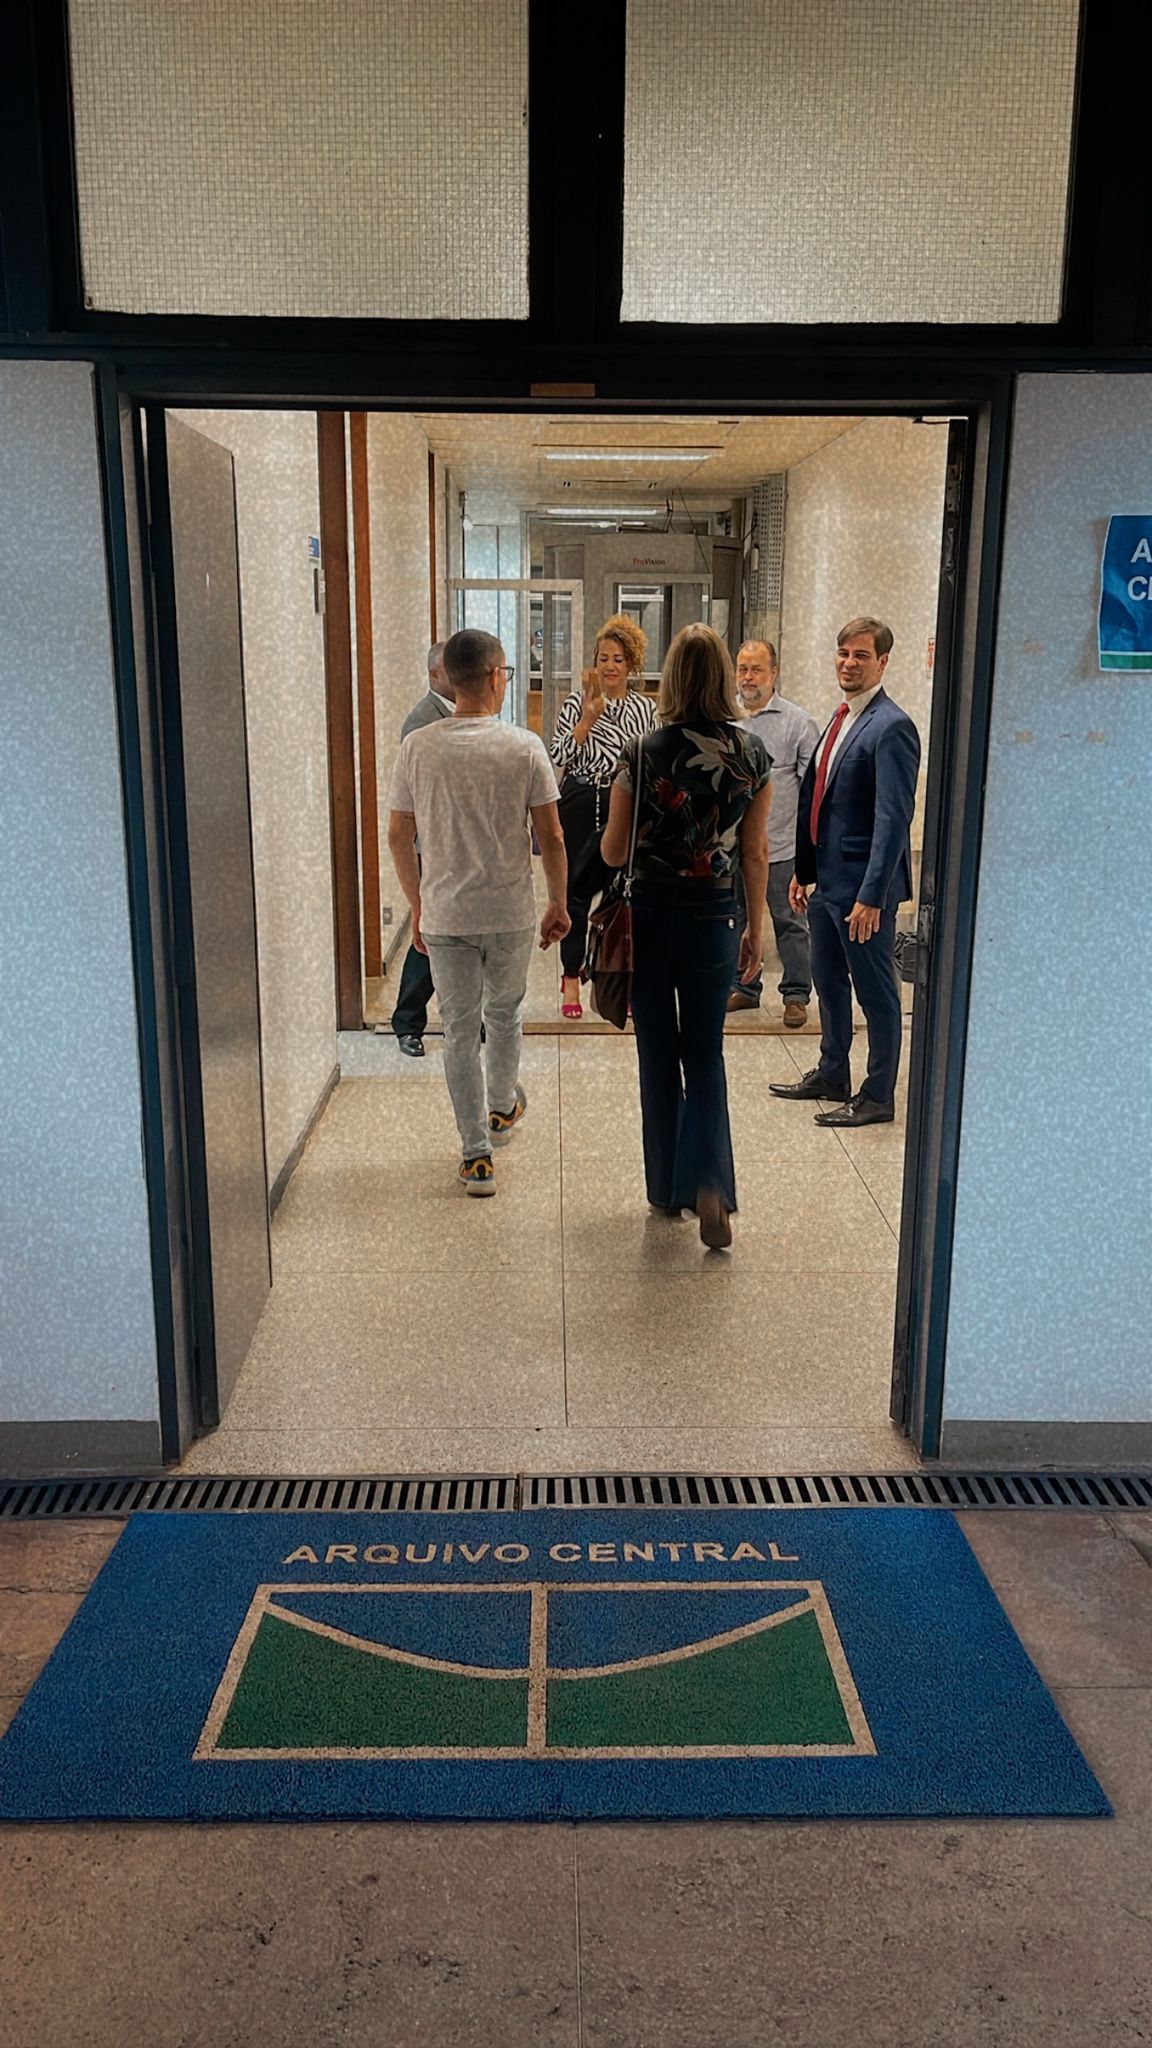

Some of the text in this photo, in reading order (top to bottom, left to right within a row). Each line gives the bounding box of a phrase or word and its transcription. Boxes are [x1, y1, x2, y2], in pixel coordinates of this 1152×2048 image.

[632, 557, 666, 566] ProVision
[1127, 575, 1152, 601] C
[283, 1542, 800, 1565] ARQUIVO CENTRAL
